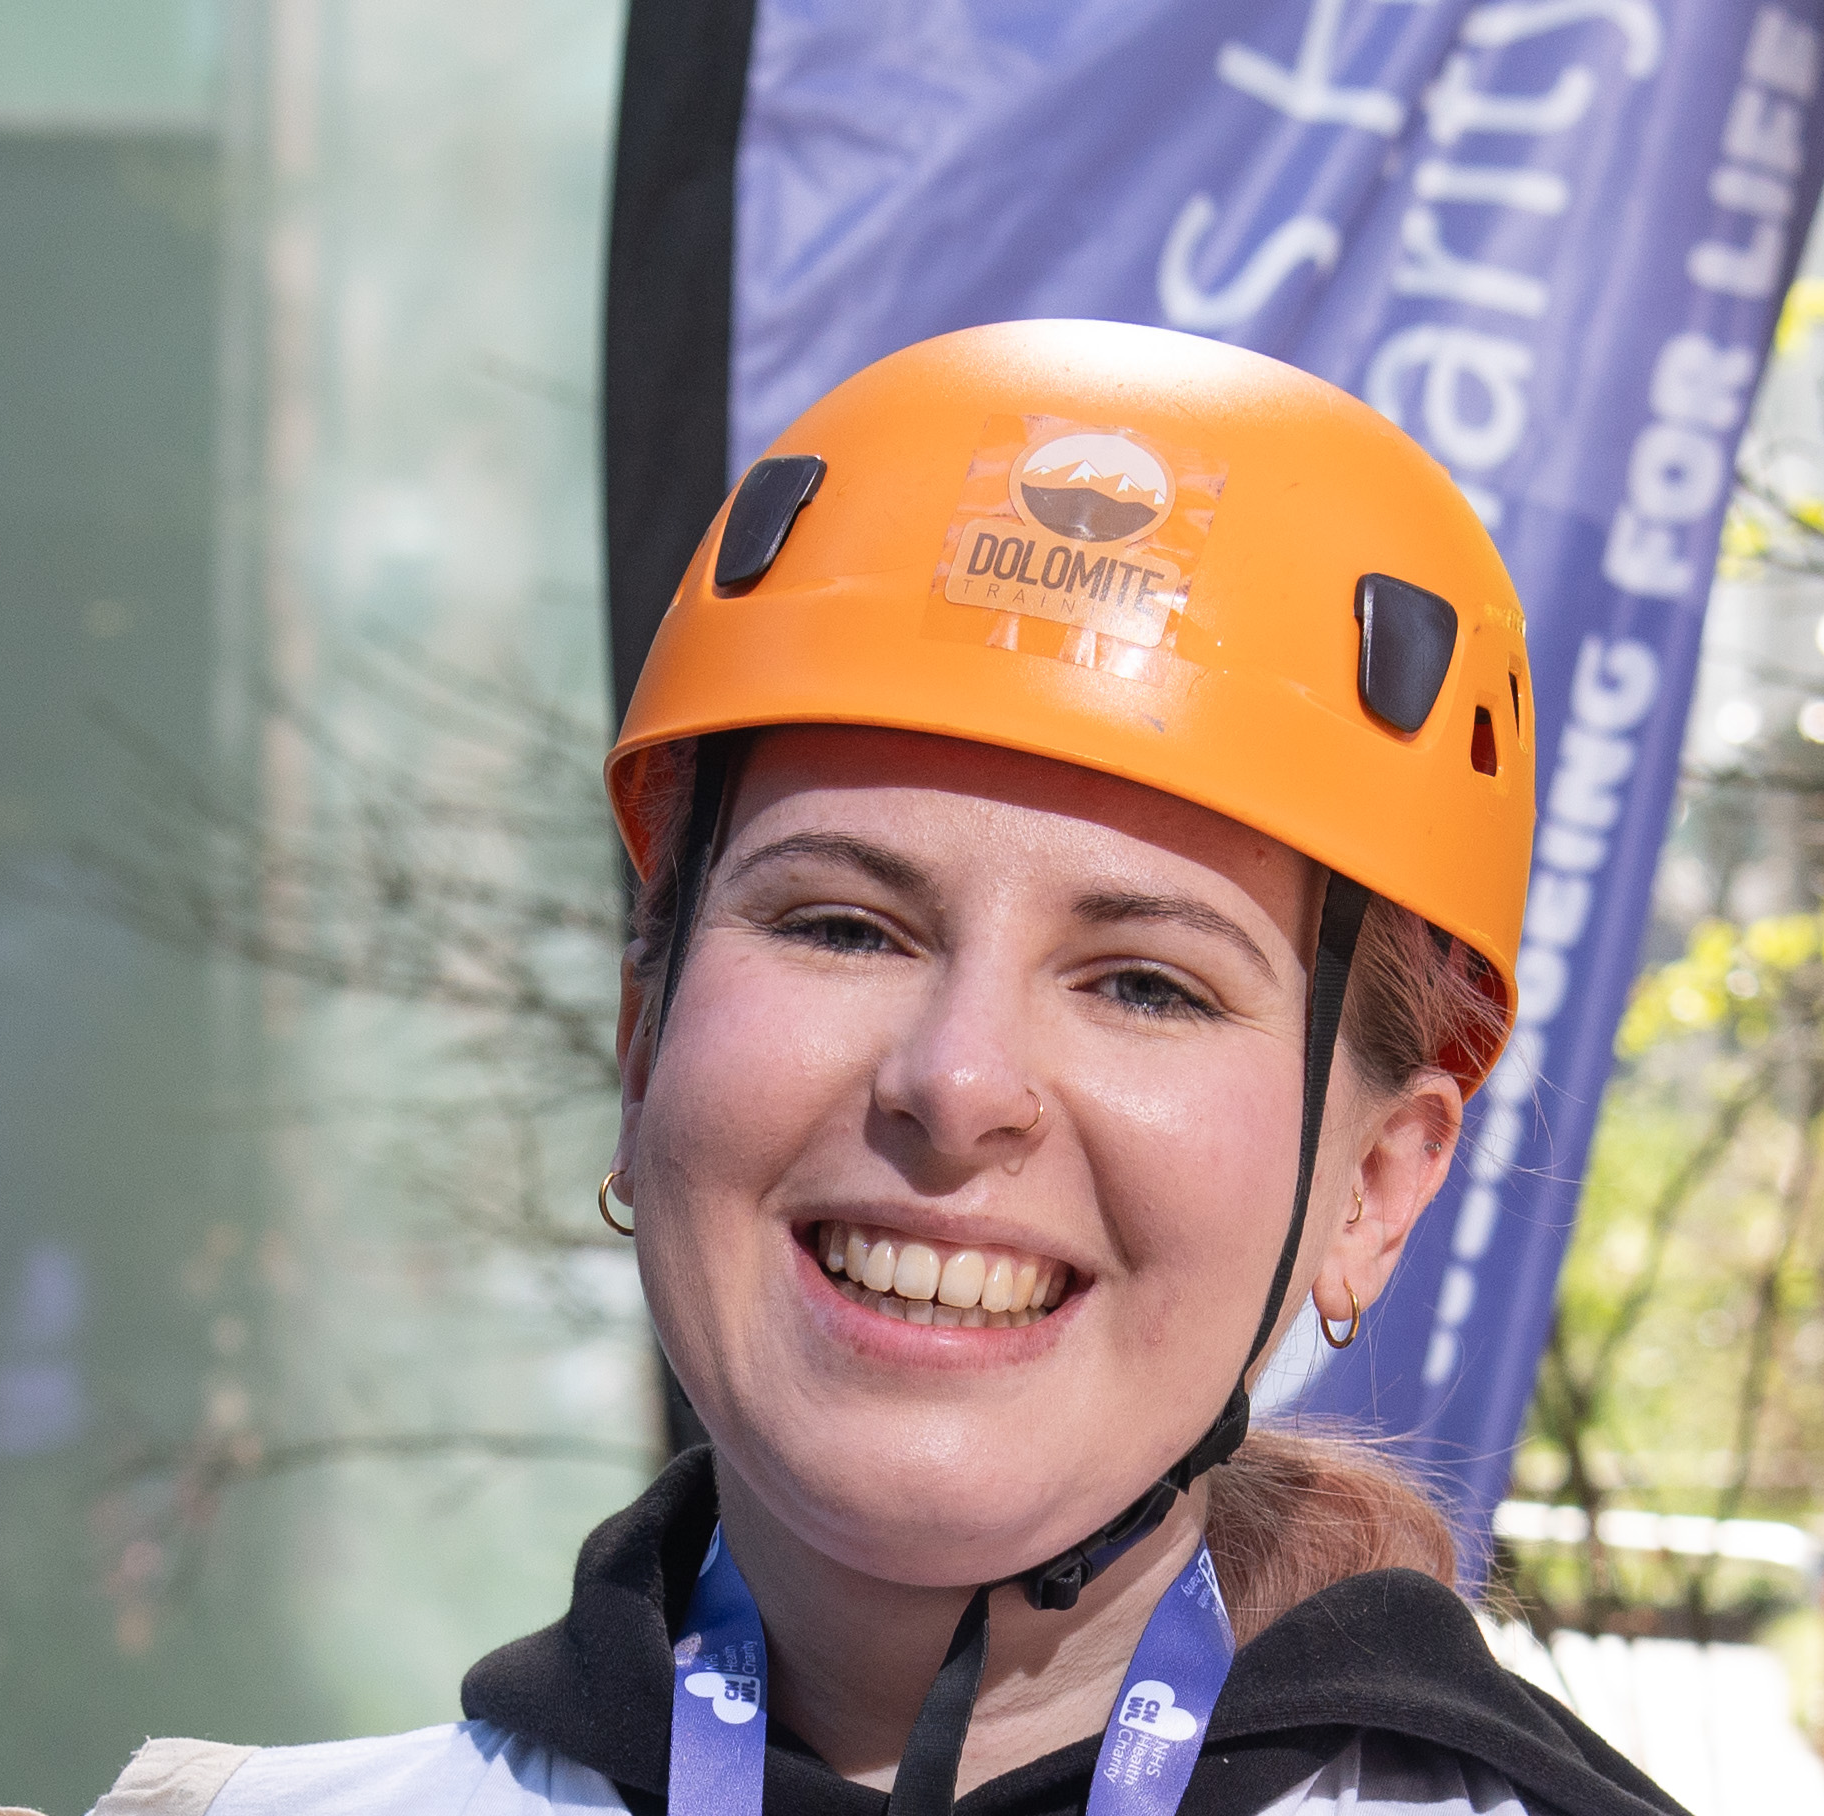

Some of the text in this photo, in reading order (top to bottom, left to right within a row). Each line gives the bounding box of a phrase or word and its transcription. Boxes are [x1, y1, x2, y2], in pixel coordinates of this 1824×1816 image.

[1367, 0, 1661, 530] arity
[1600, 330, 1759, 598] FOR
[1686, 6, 1824, 302] LIFE
[966, 532, 1165, 617] DOLOMITE
[724, 1679, 740, 1701] CN
[740, 1679, 757, 1703] WL
[1141, 1699, 1161, 1724] CN
[1146, 1740, 1171, 1778] NHS
